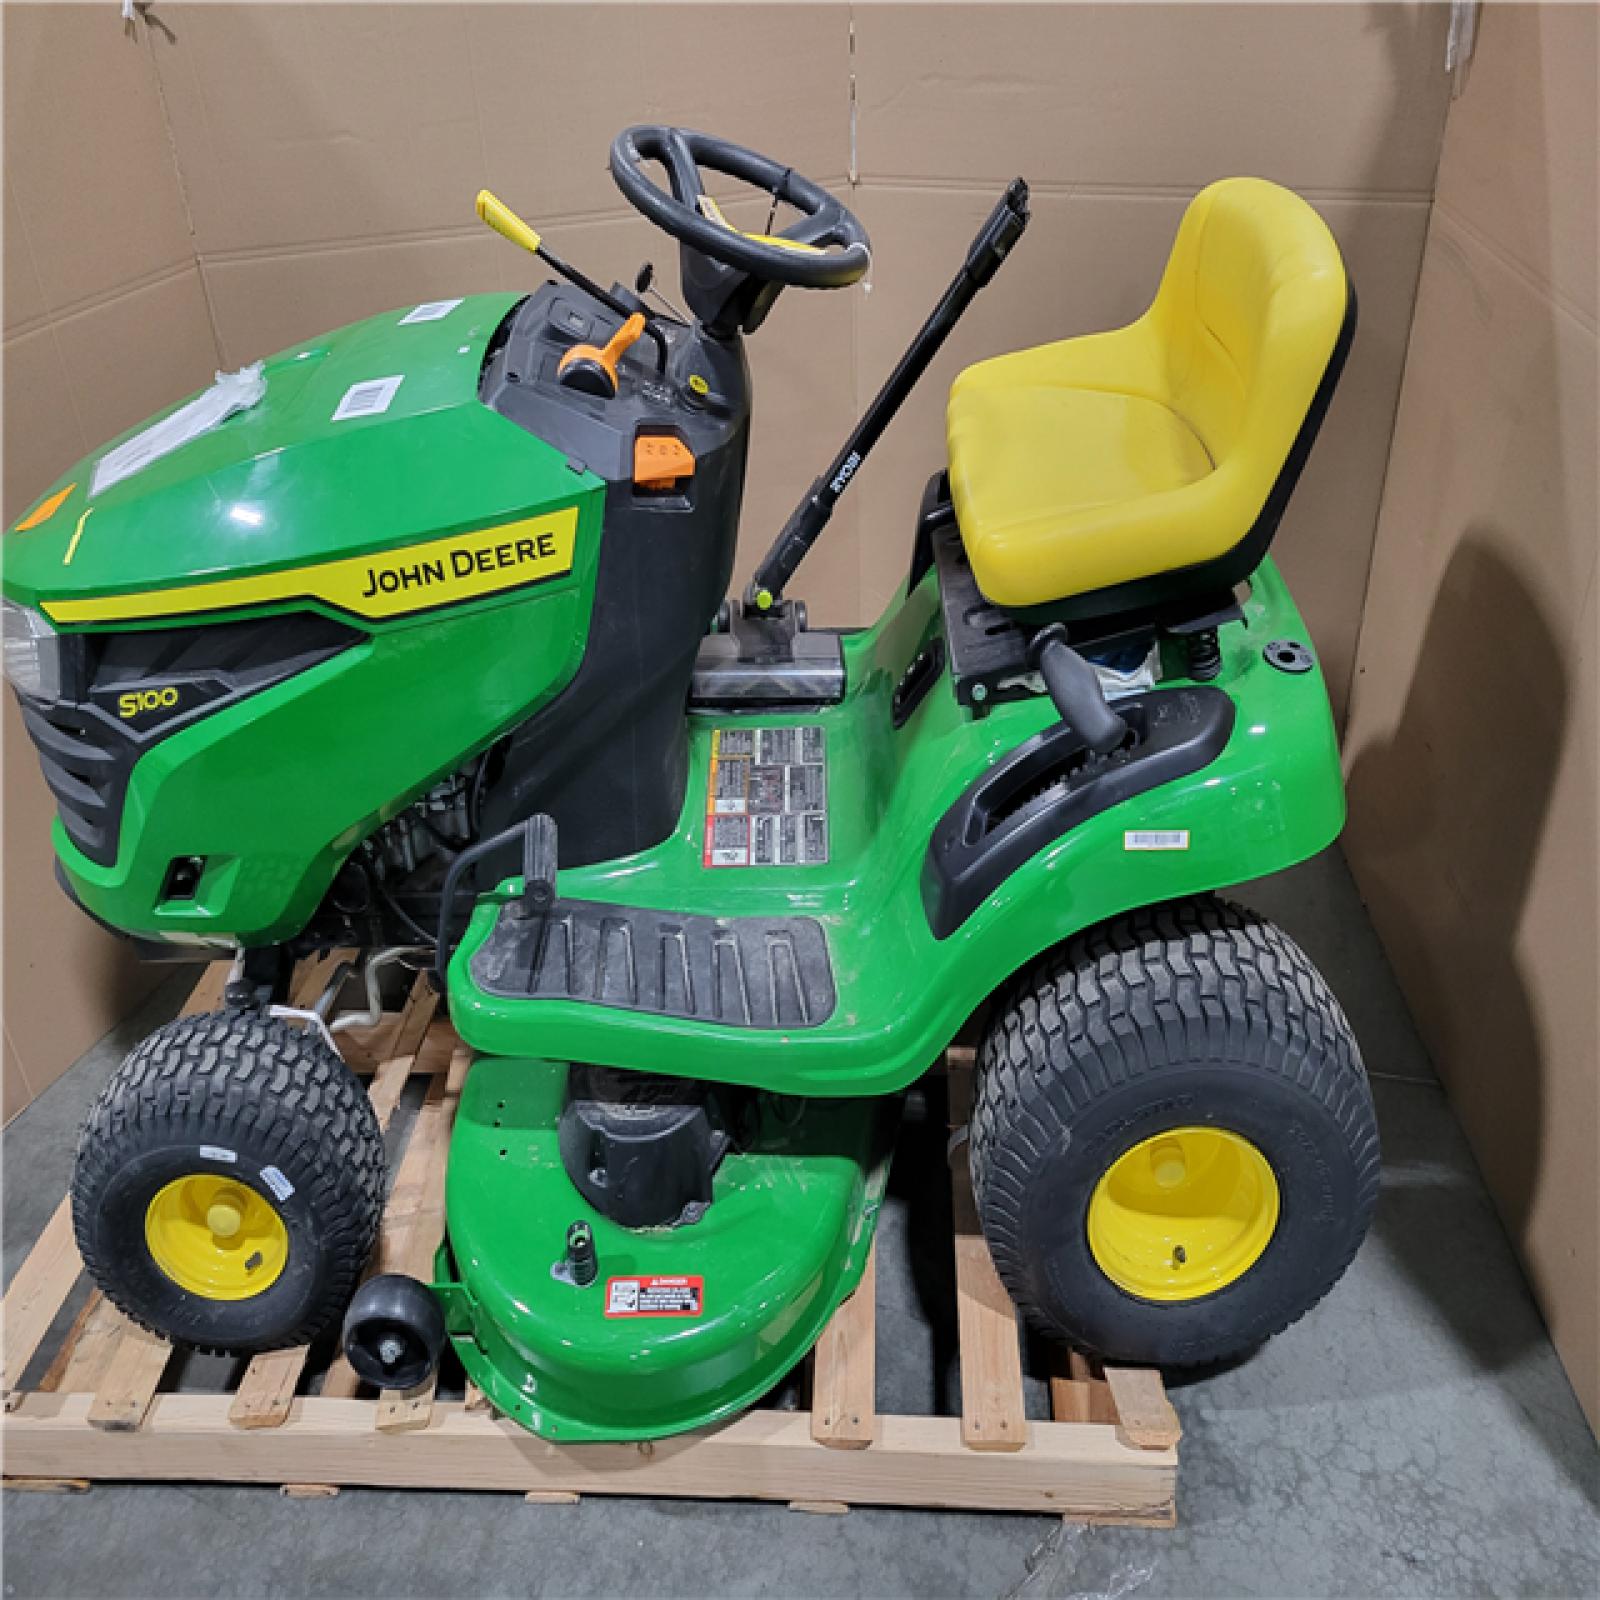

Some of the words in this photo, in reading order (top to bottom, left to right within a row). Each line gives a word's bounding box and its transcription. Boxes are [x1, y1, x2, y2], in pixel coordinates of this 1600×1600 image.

[362, 559, 446, 597] JOHN
[449, 532, 556, 578] DEERE
[119, 687, 179, 718] S100
